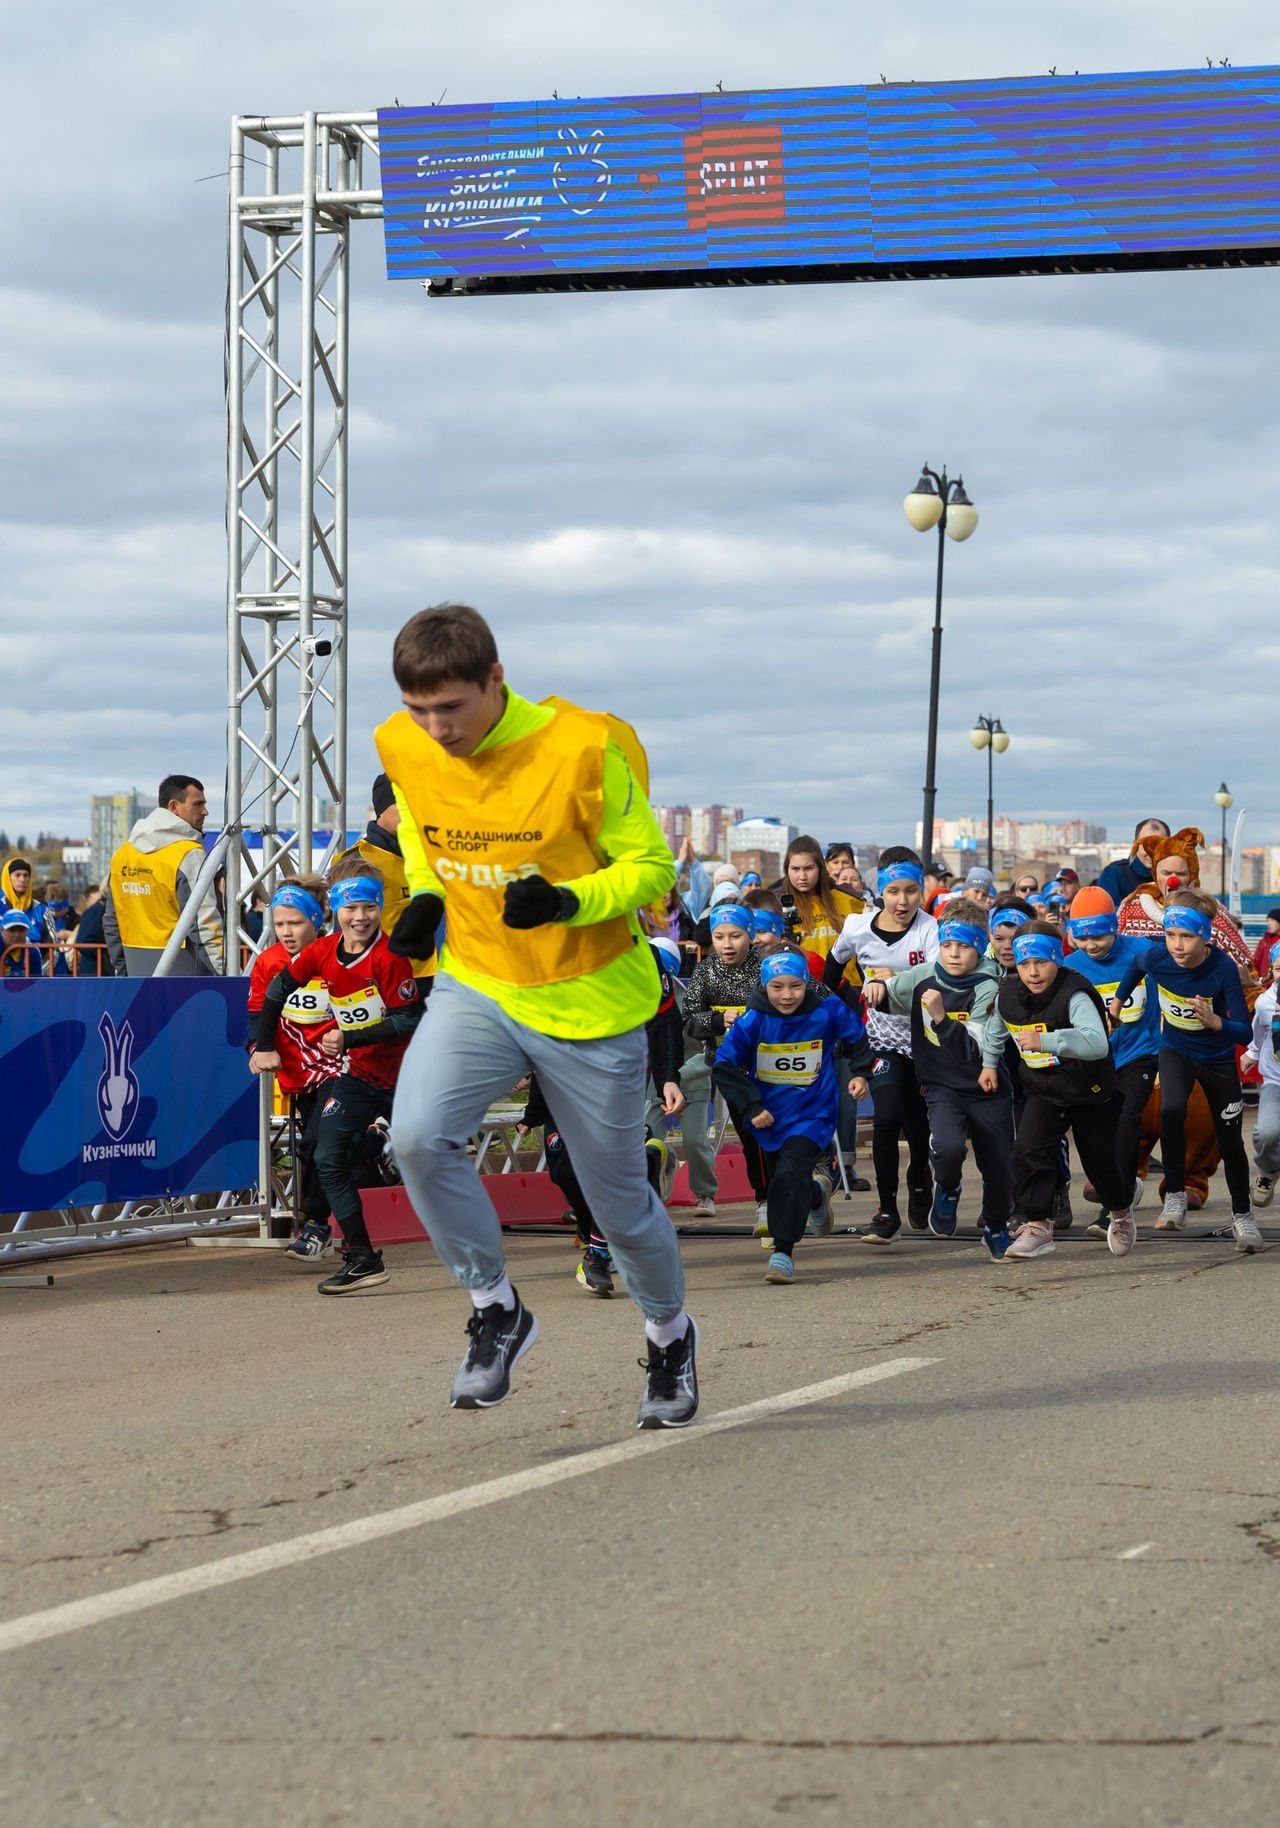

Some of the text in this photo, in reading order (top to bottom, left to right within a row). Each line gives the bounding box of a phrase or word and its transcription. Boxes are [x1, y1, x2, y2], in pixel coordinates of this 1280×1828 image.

[700, 160, 768, 196] SPLAT
[447, 829, 543, 844] КАЛАШНИКОВ
[447, 841, 489, 852] СПОРТ
[288, 994, 318, 1010] 48
[339, 1007, 370, 1024] 39
[1170, 1004, 1198, 1019] 32
[774, 1056, 807, 1071] 65
